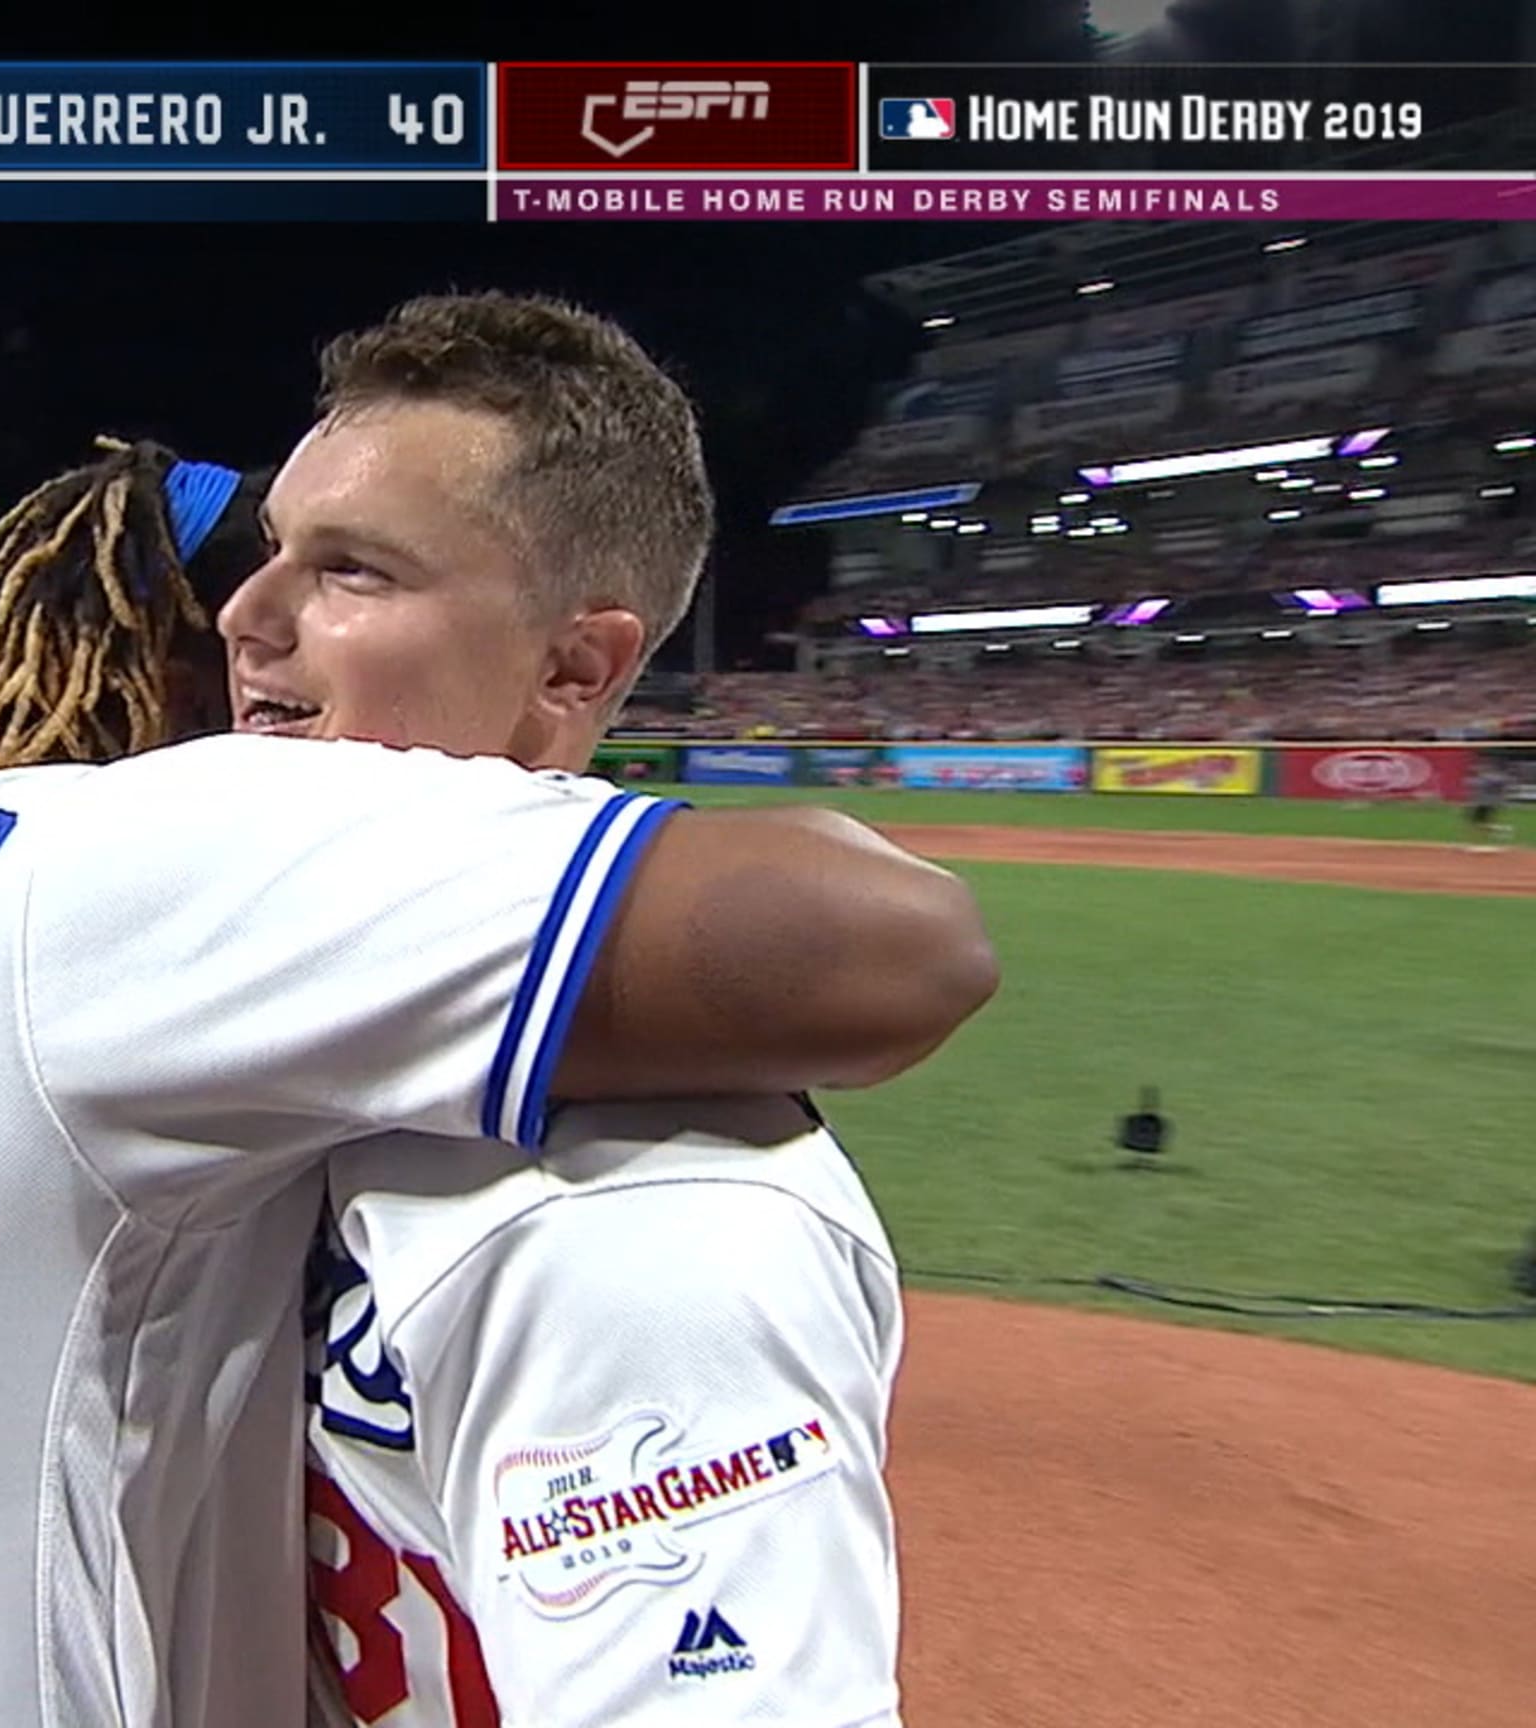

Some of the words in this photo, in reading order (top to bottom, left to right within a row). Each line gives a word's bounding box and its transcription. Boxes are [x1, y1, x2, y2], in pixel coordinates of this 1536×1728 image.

[655, 1443, 774, 1512] GAME
[560, 1537, 633, 1571] 2019
[667, 1650, 757, 1681] Majestic
